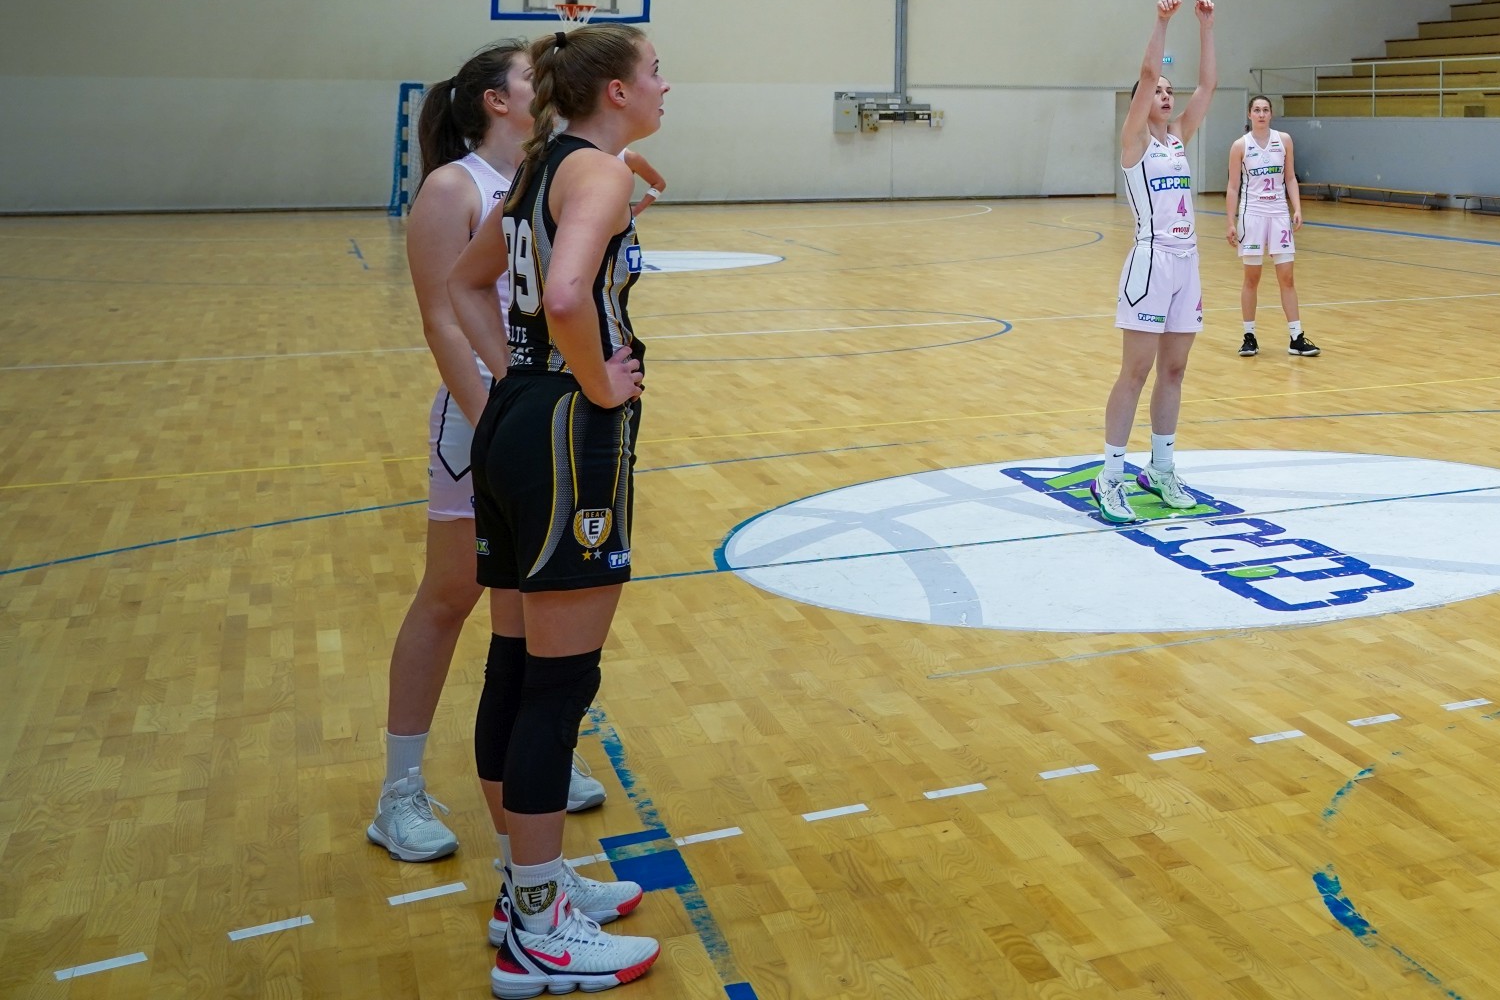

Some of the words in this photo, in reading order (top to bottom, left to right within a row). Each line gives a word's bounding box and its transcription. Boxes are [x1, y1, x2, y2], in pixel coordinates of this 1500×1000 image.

[1263, 178, 1275, 191] 21
[1177, 194, 1187, 216] 4
[1280, 230, 1292, 243] 21
[589, 520, 599, 535] E
